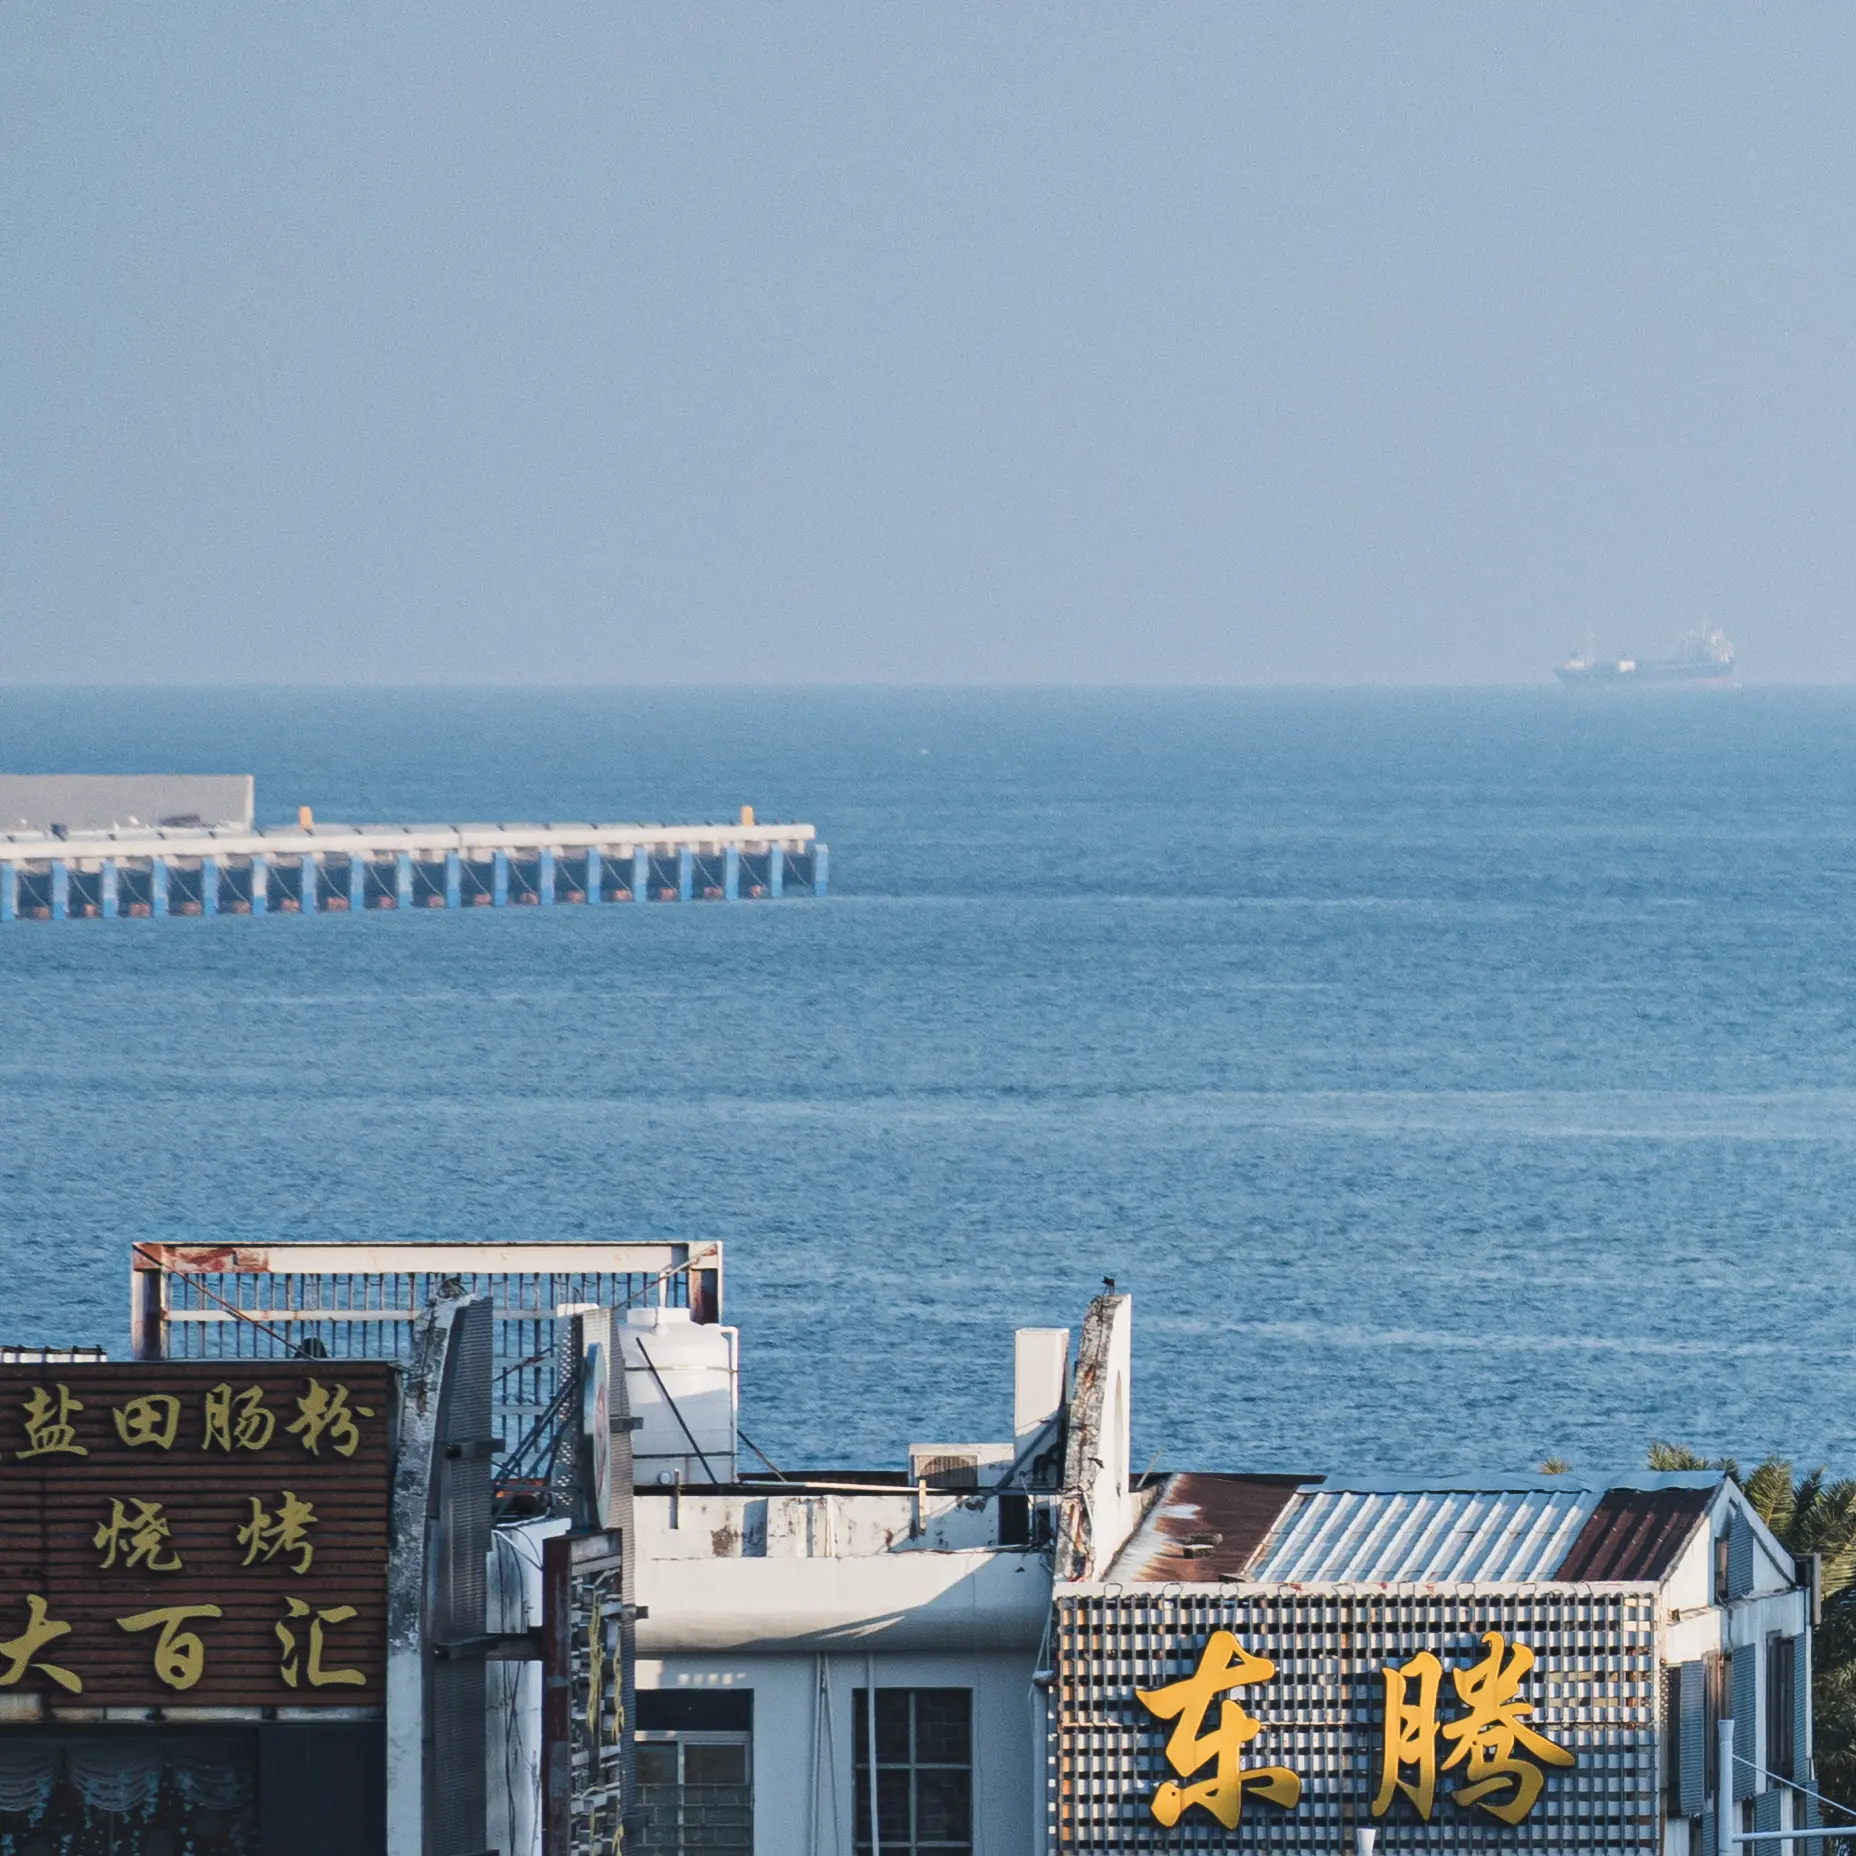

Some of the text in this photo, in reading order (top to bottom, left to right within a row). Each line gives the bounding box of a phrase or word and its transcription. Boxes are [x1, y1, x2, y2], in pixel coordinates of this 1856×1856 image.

[16, 1378, 374, 1459] 盐田肠粉
[93, 1491, 318, 1574] 烧烤
[0, 1595, 366, 1693] 大百汇
[1136, 1630, 1576, 1830] 东腾
